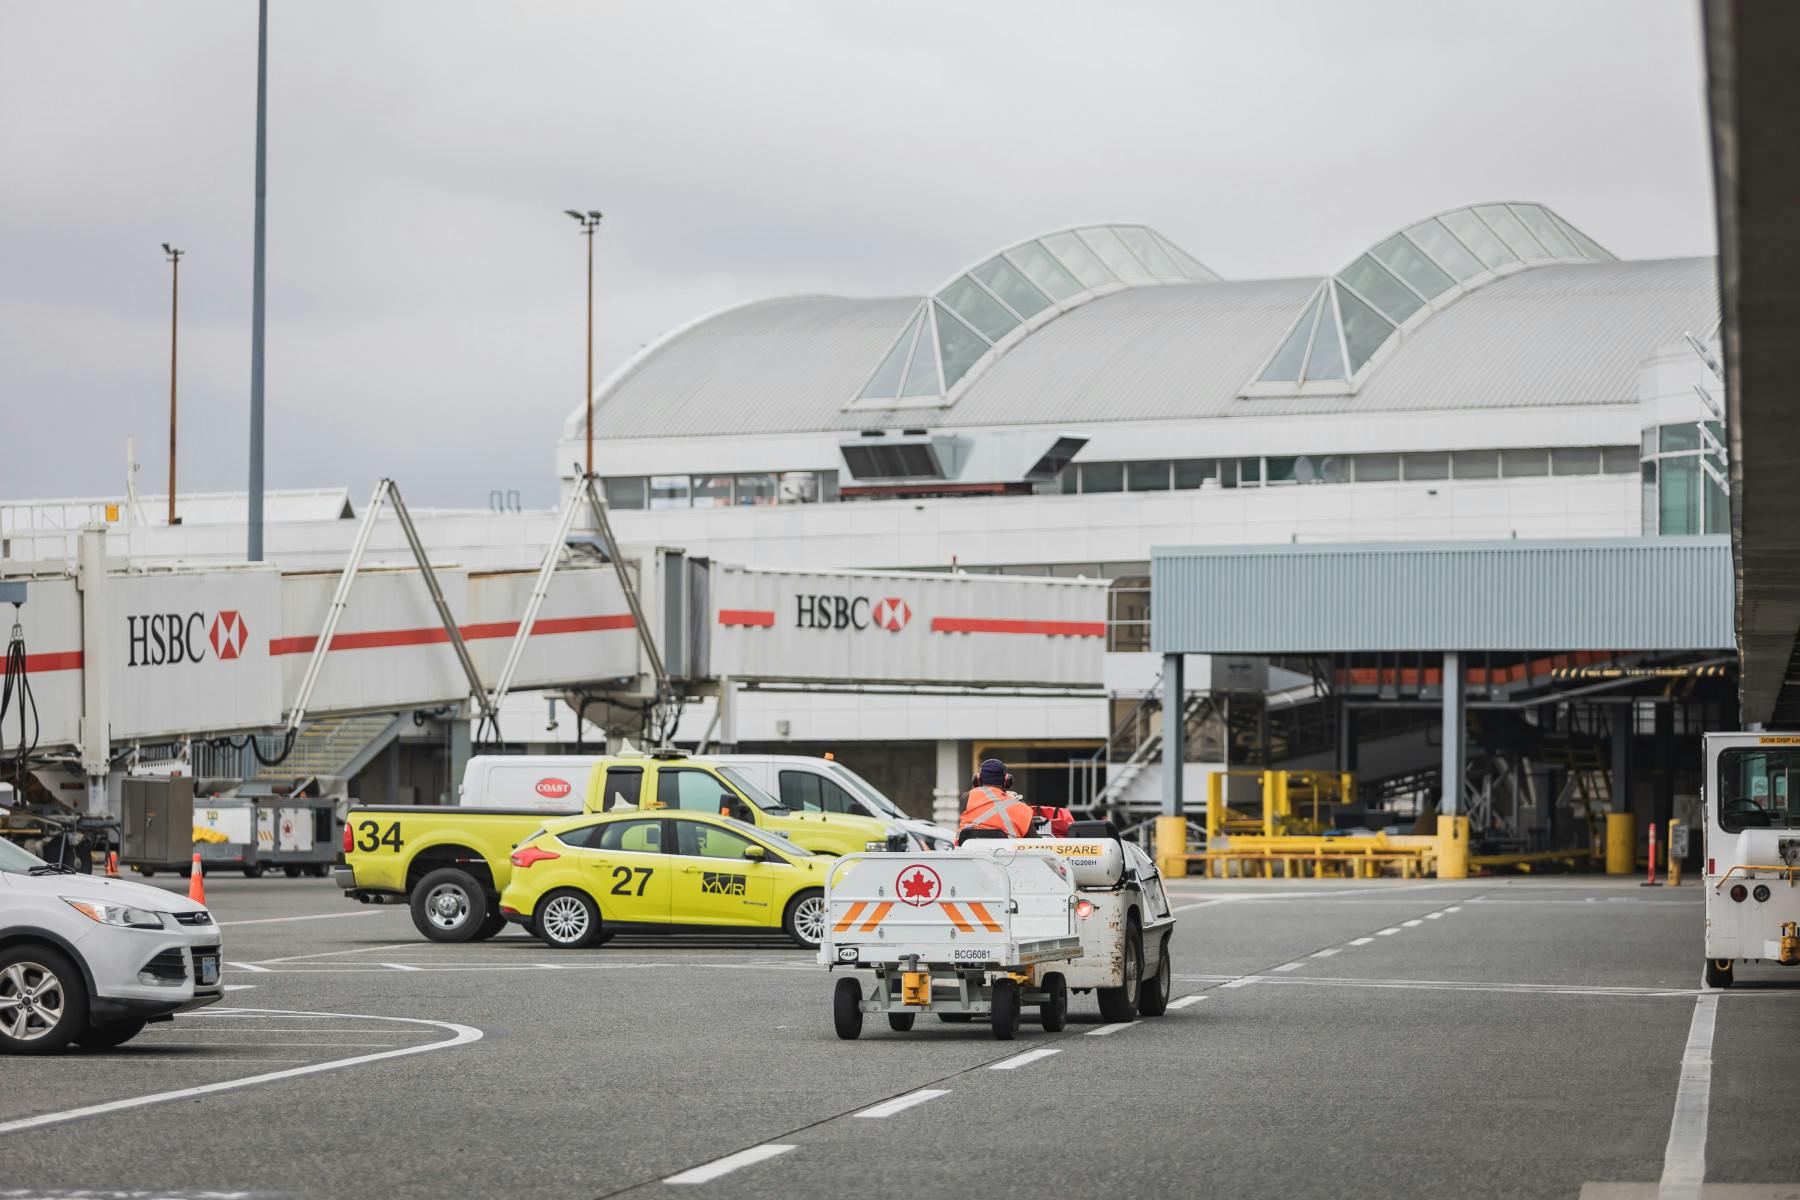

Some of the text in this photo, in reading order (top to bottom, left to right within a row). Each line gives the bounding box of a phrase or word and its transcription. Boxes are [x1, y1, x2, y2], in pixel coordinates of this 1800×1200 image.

[795, 594, 870, 631] HSBC
[127, 611, 205, 667] HSBC
[537, 783, 569, 793] COAST
[357, 820, 405, 853] 34
[1056, 845, 1098, 855] SPARE
[611, 866, 654, 897] 27
[702, 879, 746, 897] YVR
[954, 950, 991, 960] BCG6081
